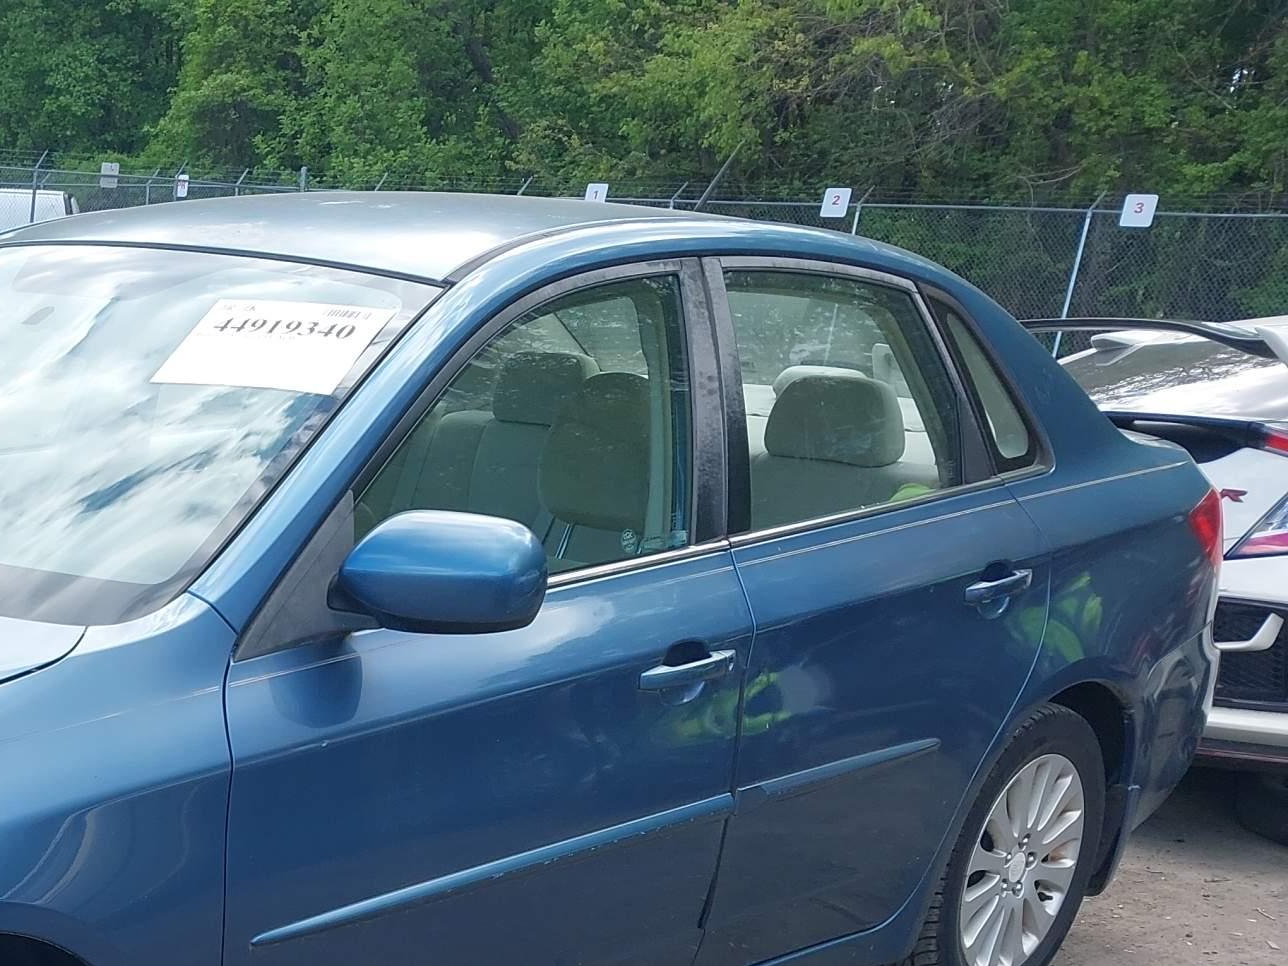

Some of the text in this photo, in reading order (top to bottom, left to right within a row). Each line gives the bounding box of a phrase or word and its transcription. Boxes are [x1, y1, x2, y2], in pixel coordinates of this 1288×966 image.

[831, 194, 841, 206] 2
[1133, 202, 1145, 214] 3
[213, 317, 356, 340] 44919340
